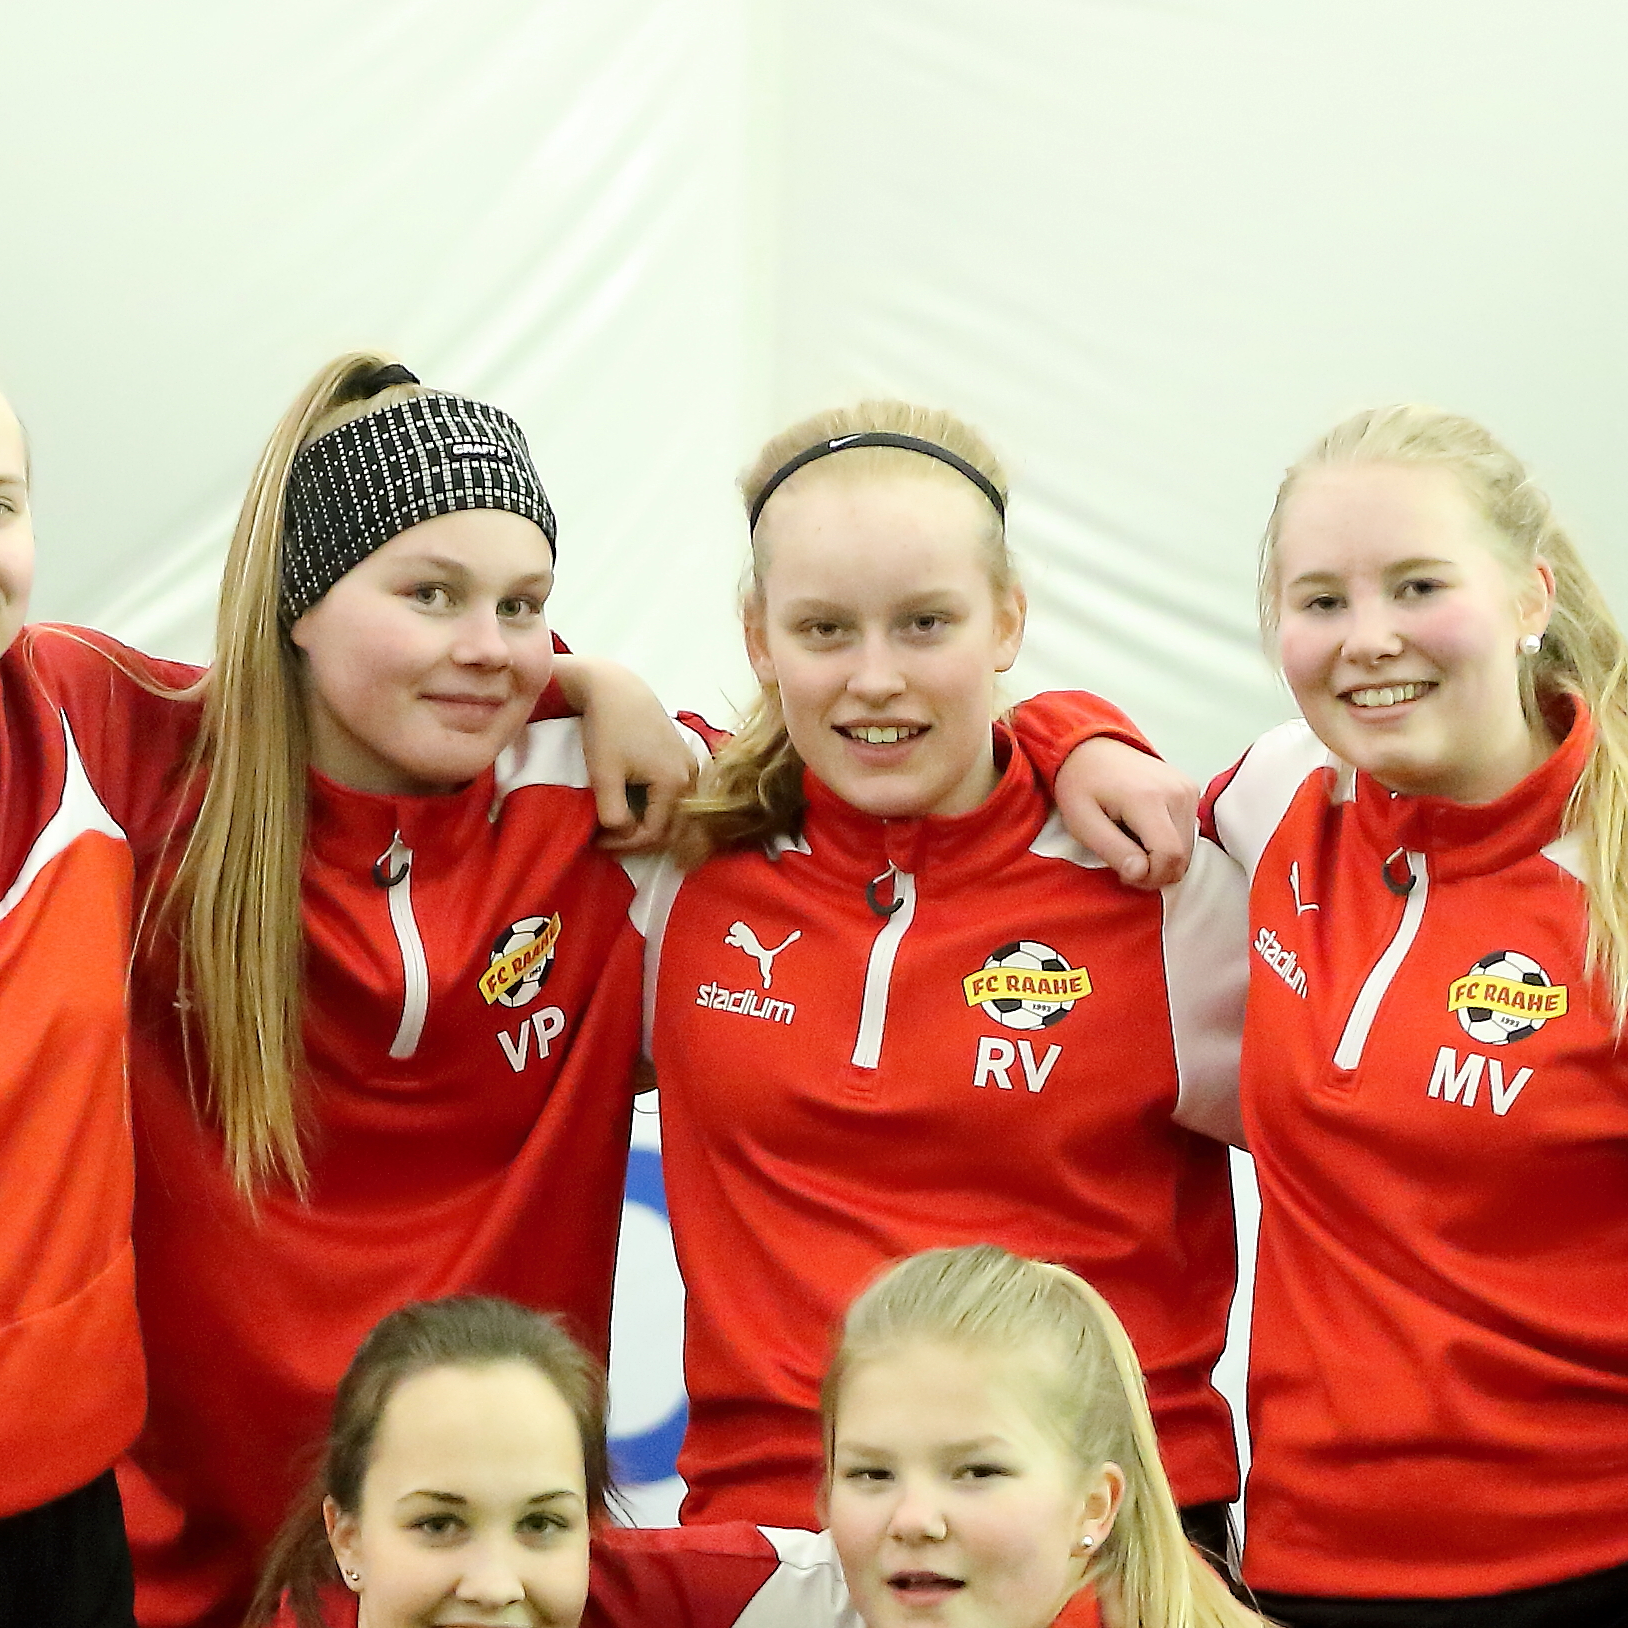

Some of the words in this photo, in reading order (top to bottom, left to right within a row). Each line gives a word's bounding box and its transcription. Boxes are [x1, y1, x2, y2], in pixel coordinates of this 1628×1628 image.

[485, 965, 509, 995] FC
[694, 980, 797, 1026] stadium
[972, 975, 999, 996] FC
[1006, 974, 1083, 996] RAAHE
[1454, 980, 1480, 1003] FC
[1483, 983, 1561, 1012] RAAHE
[496, 1005, 566, 1074] VP
[972, 1035, 1064, 1094] RV
[1426, 1044, 1535, 1116] MV
